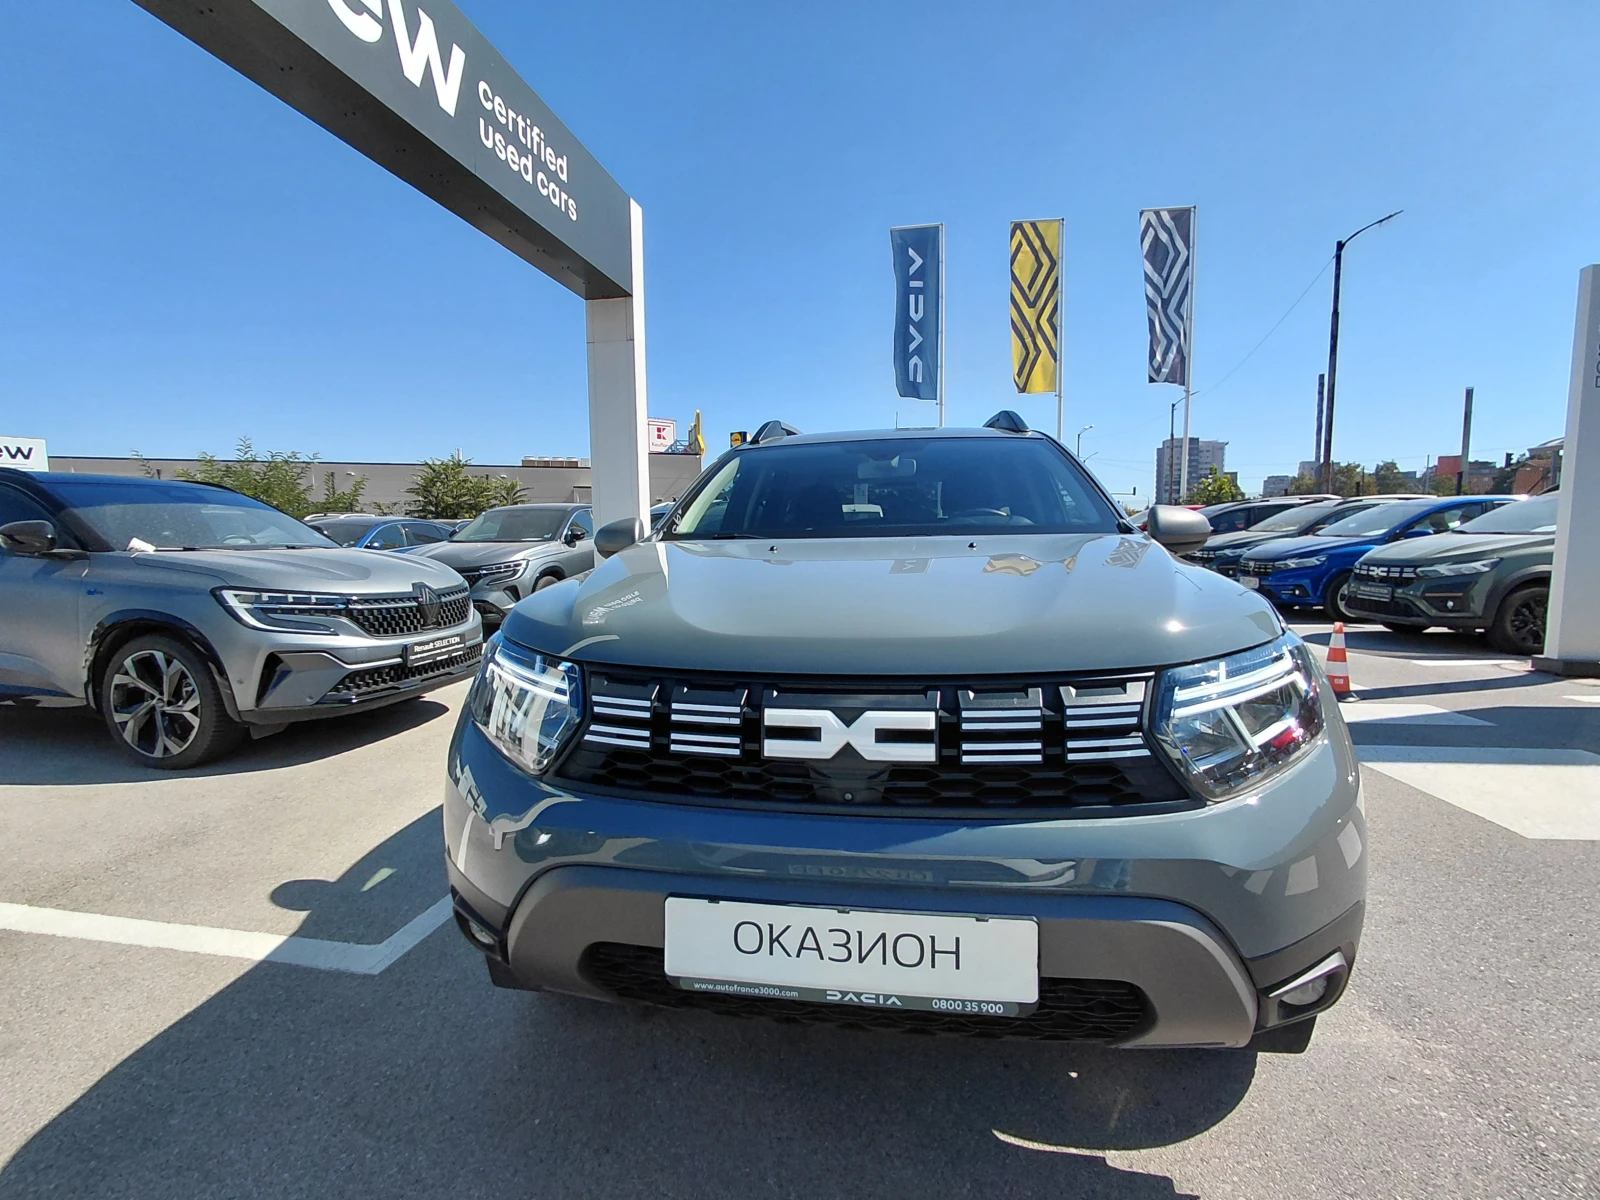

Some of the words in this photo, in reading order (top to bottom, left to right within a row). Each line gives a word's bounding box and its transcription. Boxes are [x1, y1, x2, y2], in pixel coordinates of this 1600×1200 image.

[478, 80, 568, 184] certified
[479, 117, 533, 185] used
[536, 171, 578, 222] cars
[434, 637, 460, 648] SELECTION
[732, 919, 961, 971] ОКАЗИОН
[693, 981, 799, 998] www.autofrance3000.com
[825, 989, 903, 1006] DACIA
[931, 998, 963, 1011] 0800
[964, 1001, 979, 1012] 35
[981, 1002, 1004, 1014] 900
